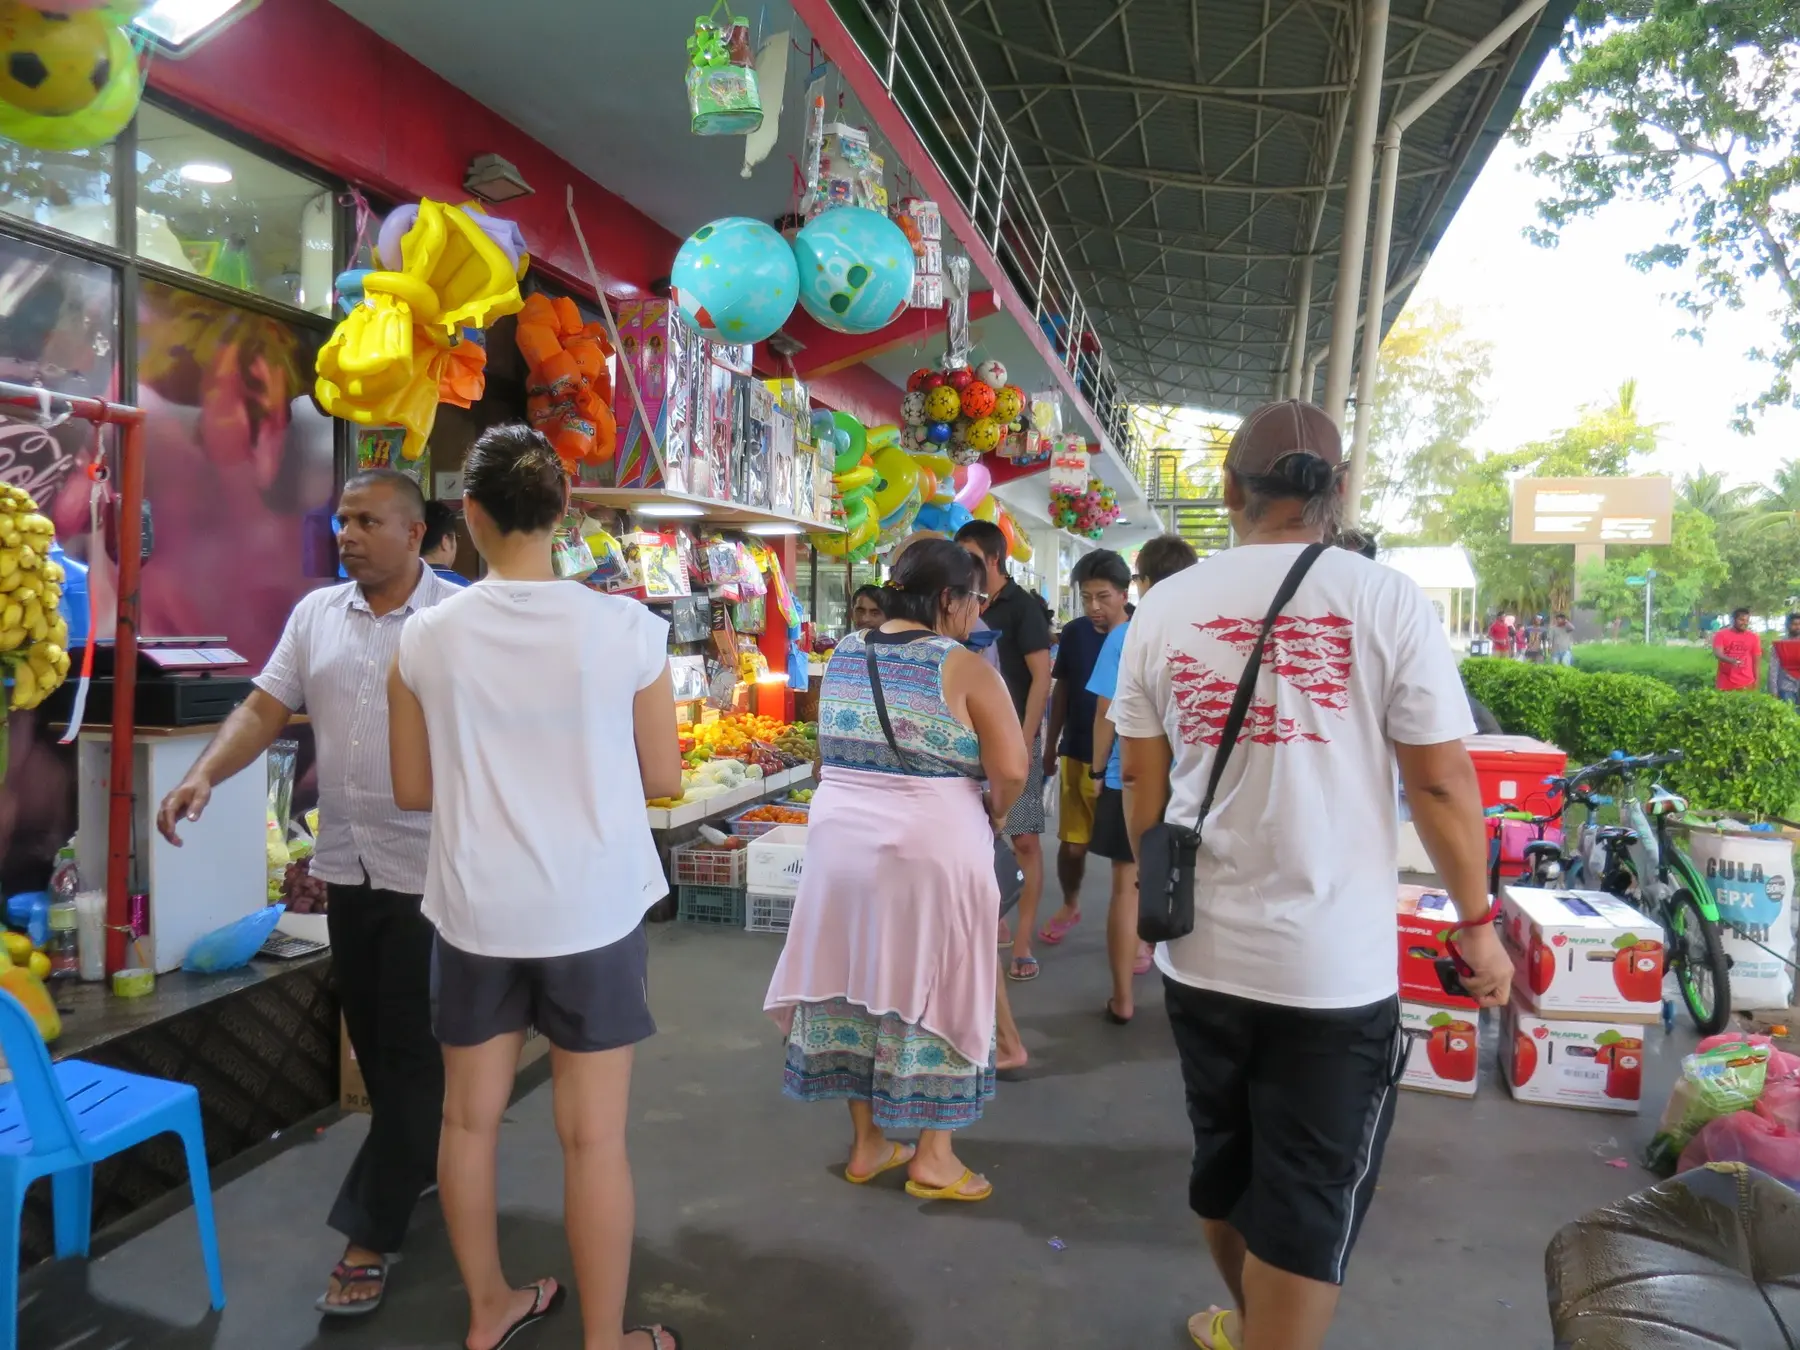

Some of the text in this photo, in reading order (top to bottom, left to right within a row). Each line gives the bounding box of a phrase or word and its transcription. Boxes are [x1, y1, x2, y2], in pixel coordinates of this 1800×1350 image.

[1236, 644, 1252, 652] DIVE
[1706, 858, 1764, 883] GULA
[1716, 887, 1754, 908] EPX
